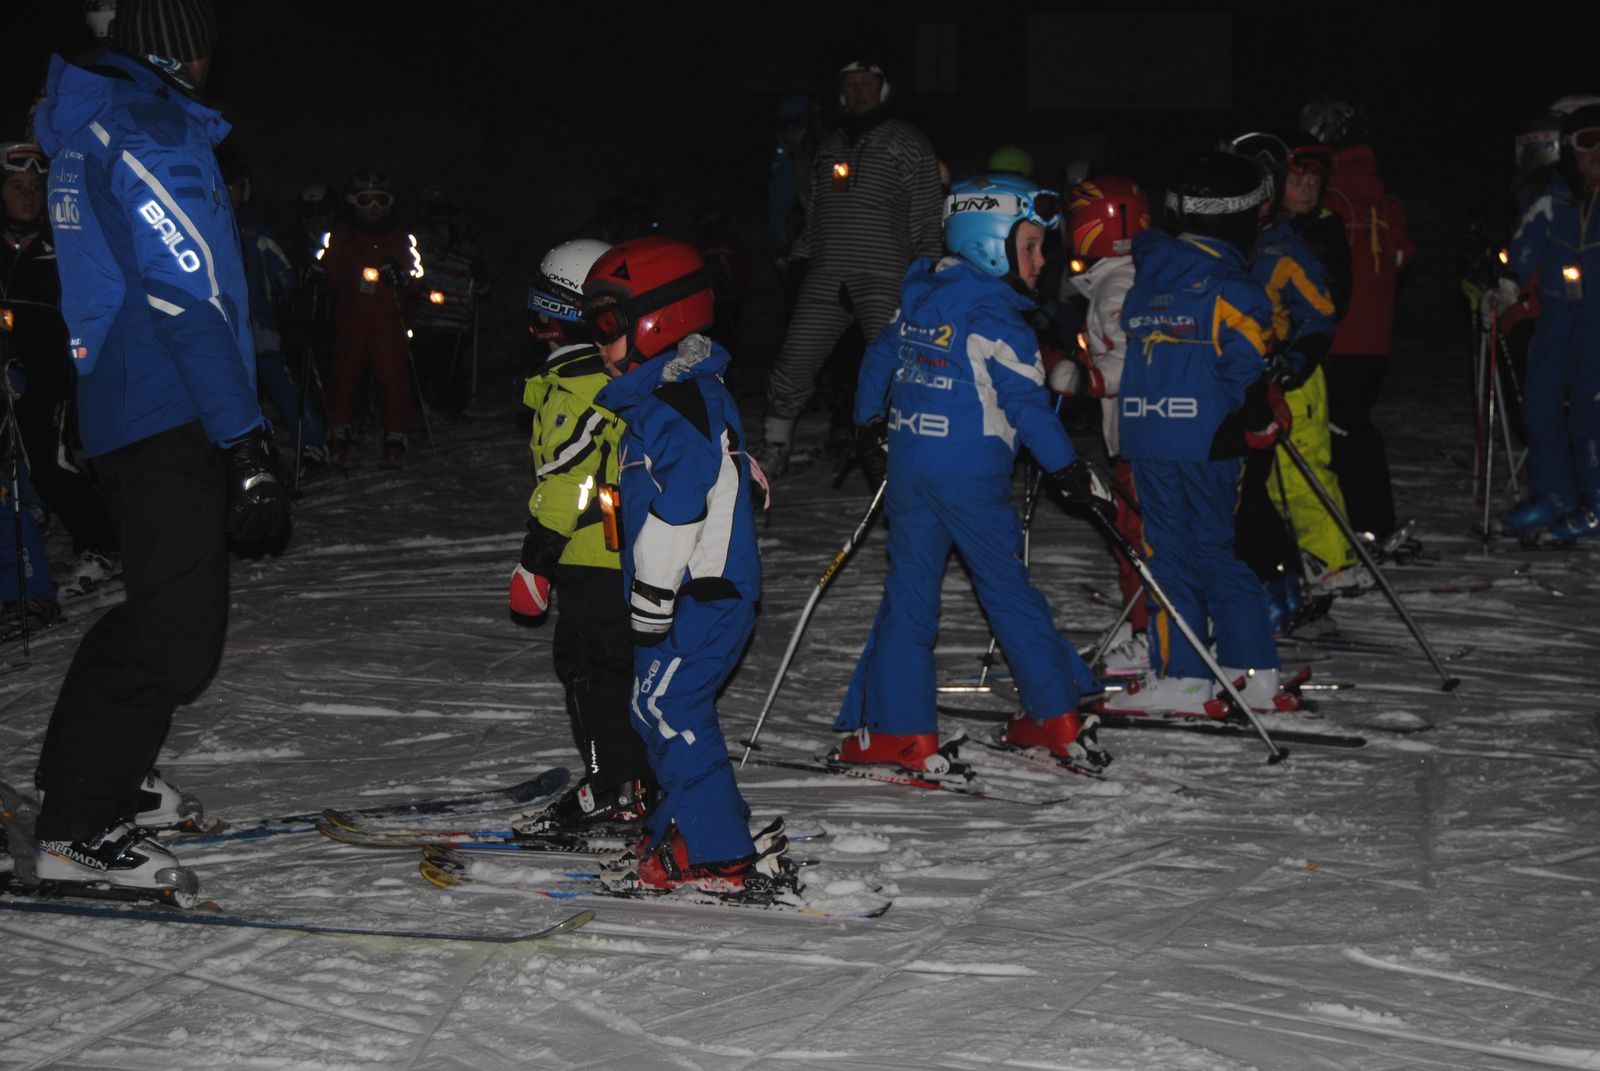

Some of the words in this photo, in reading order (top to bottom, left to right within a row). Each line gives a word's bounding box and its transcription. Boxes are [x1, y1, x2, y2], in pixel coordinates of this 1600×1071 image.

[140, 200, 201, 273] BAILO
[1122, 396, 1199, 419] DKB
[640, 659, 662, 694] DKB
